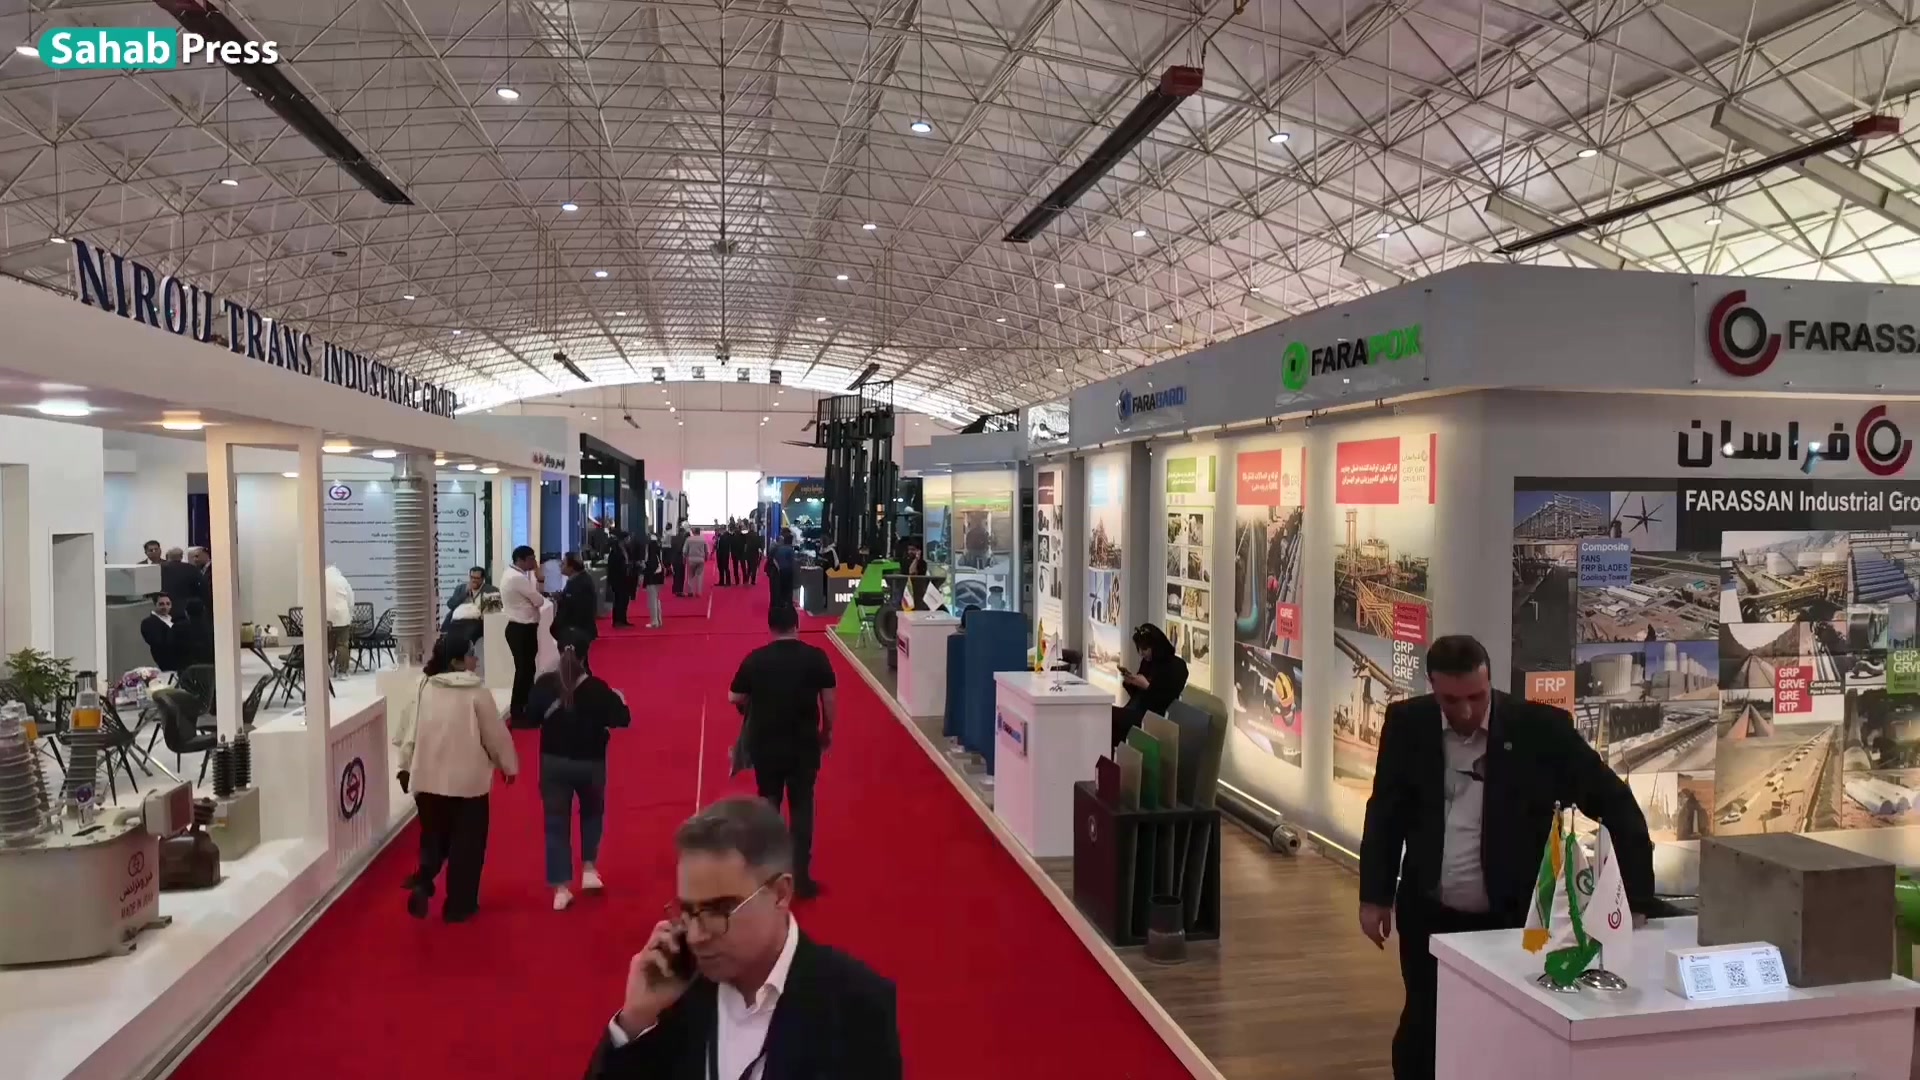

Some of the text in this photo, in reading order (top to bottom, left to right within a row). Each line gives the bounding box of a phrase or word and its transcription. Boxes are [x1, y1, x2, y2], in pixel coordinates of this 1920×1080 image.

[72, 237, 213, 343] NIROU
[221, 298, 313, 376] TRANS
[322, 340, 420, 410] INDUSTRIAL
[1311, 322, 1422, 377] FARAPOX
[1678, 420, 1850, 475] فراسان
[1685, 490, 1793, 512] FARASSAN
[1799, 490, 1884, 512] Industrial
[1581, 542, 1629, 552] Composite
[1580, 554, 1601, 562] FANS
[1580, 563, 1628, 572] FRP BLADES
[1393, 639, 1414, 654] GRP
[1393, 652, 1419, 669] GRVE
[1893, 650, 1918, 662] GRP
[1392, 665, 1413, 680] GRE
[1779, 667, 1800, 678] GRP
[1535, 677, 1566, 693] FRP
[1779, 678, 1806, 689] GRVE
[1779, 690, 1800, 701] GRE
[1779, 702, 1798, 712] RTP
